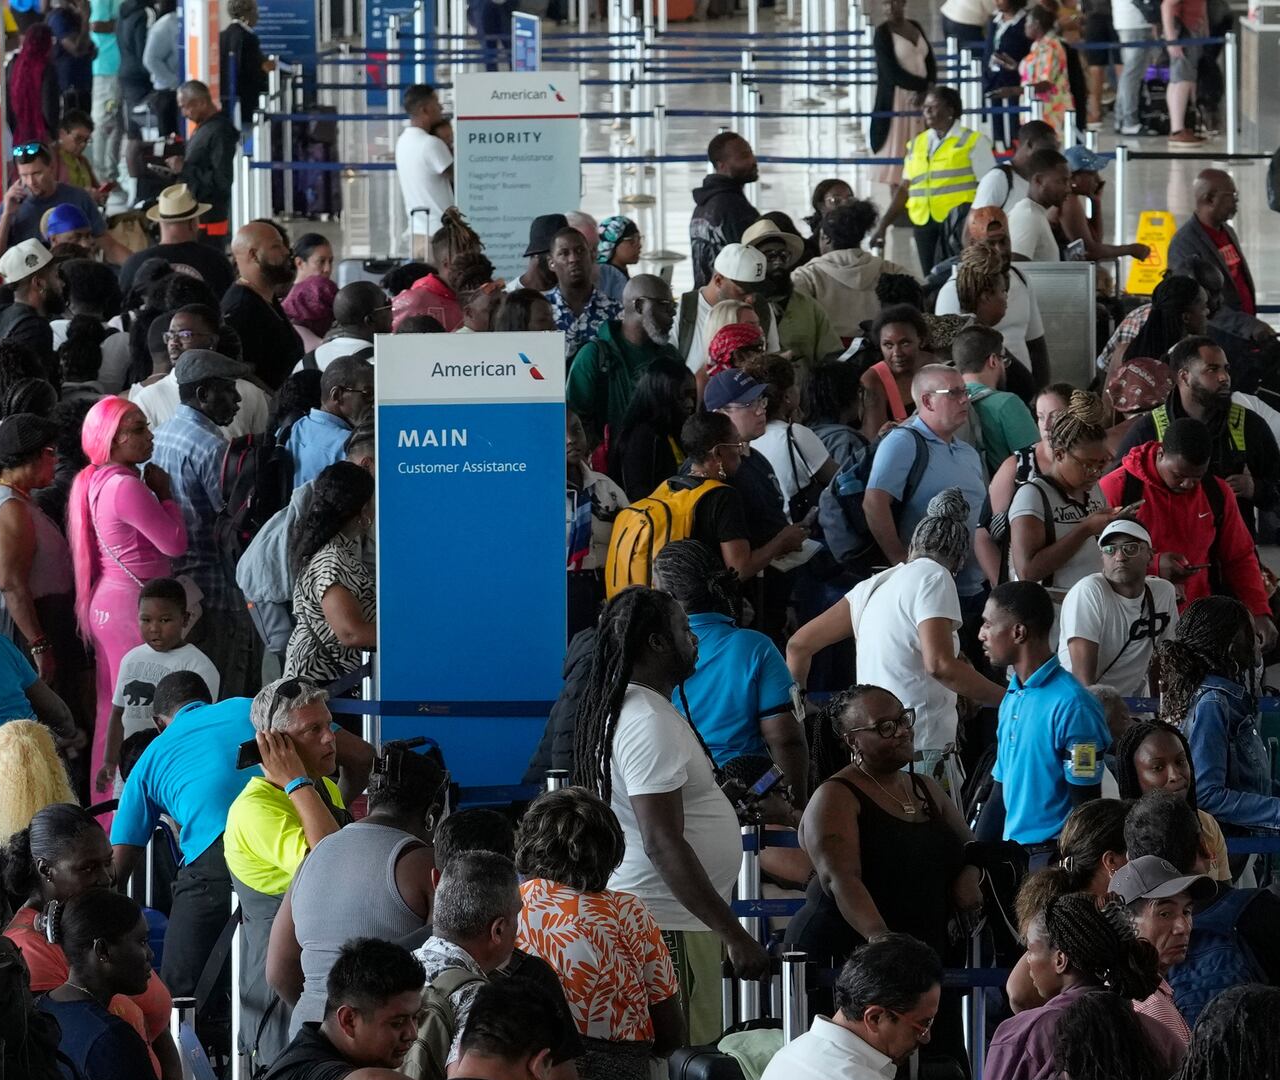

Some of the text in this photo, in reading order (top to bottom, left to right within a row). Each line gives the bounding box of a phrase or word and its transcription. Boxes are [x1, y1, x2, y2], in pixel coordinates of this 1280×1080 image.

[491, 89, 547, 100] American
[469, 131, 542, 144] PRIORITY
[431, 361, 516, 377] American
[397, 428, 468, 448] MAIN
[398, 460, 527, 474] Customer Assistance
